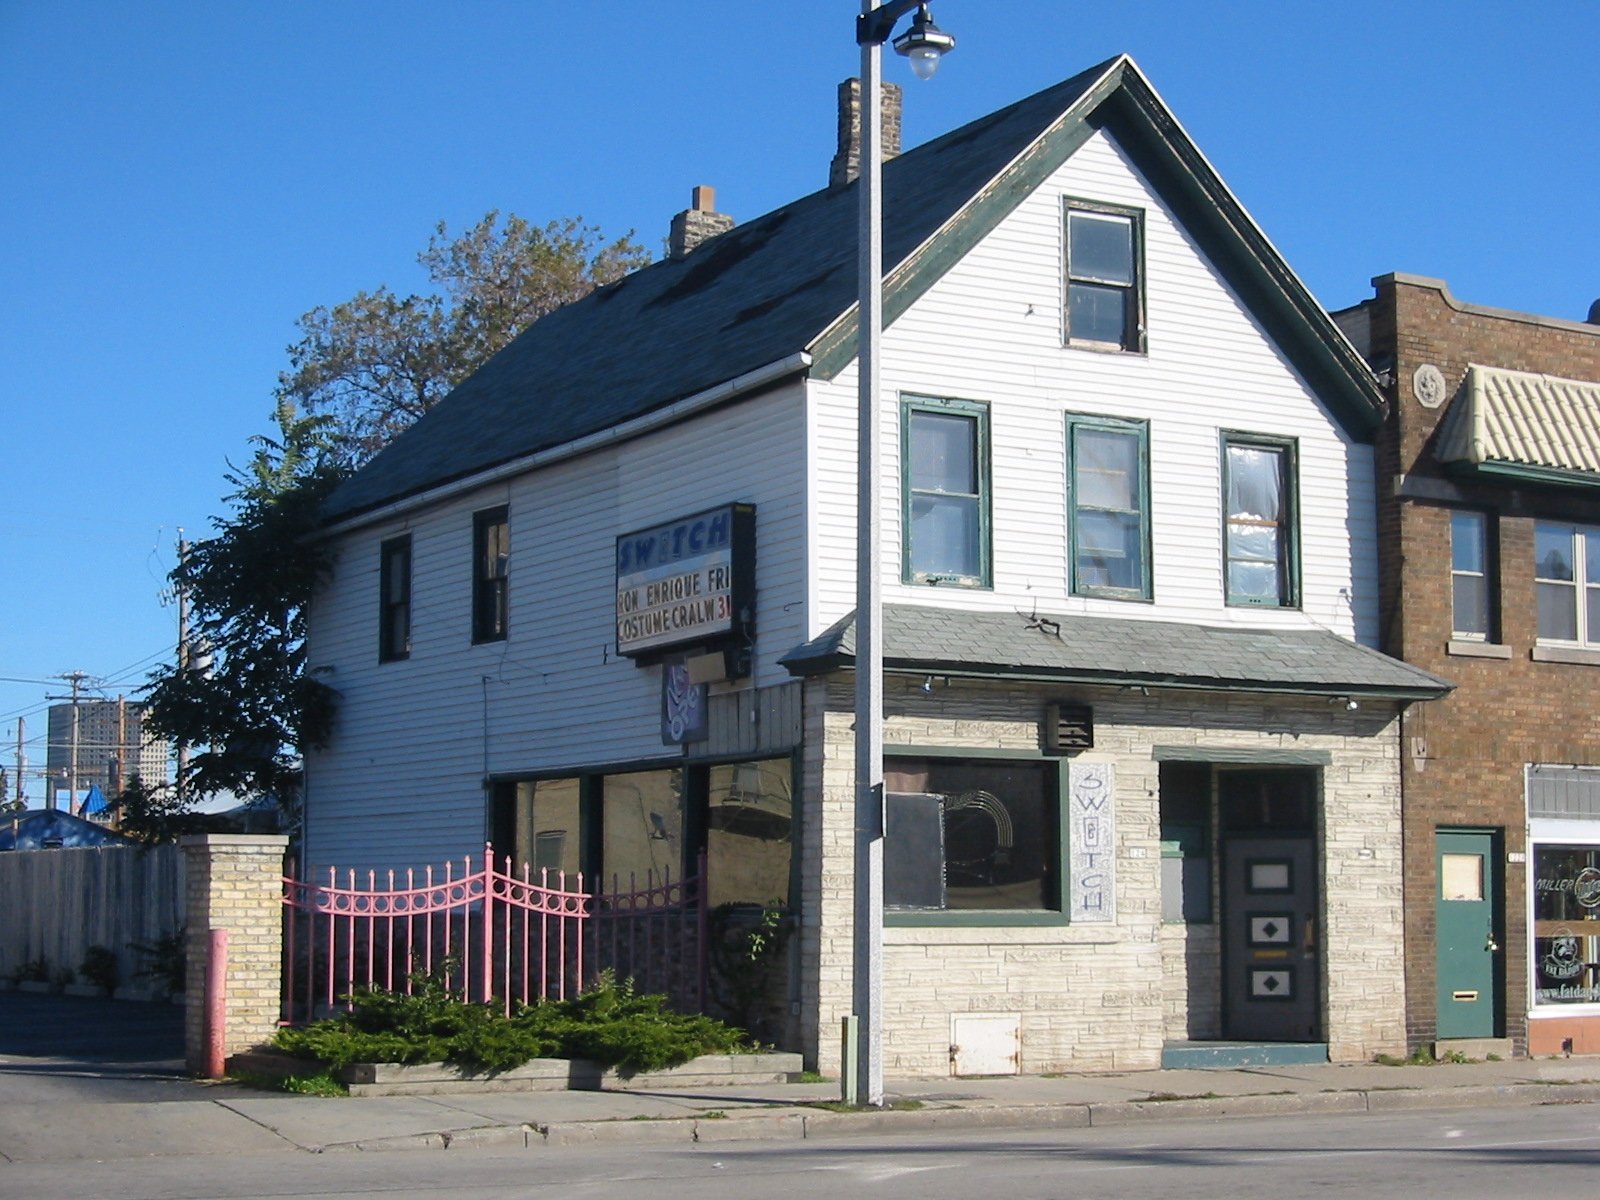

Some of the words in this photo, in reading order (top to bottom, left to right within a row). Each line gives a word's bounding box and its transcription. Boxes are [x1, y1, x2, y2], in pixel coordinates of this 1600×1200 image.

[647, 573, 700, 606] ENRIQUE
[708, 565, 729, 592] FRI
[1536, 878, 1574, 891] MILLER
